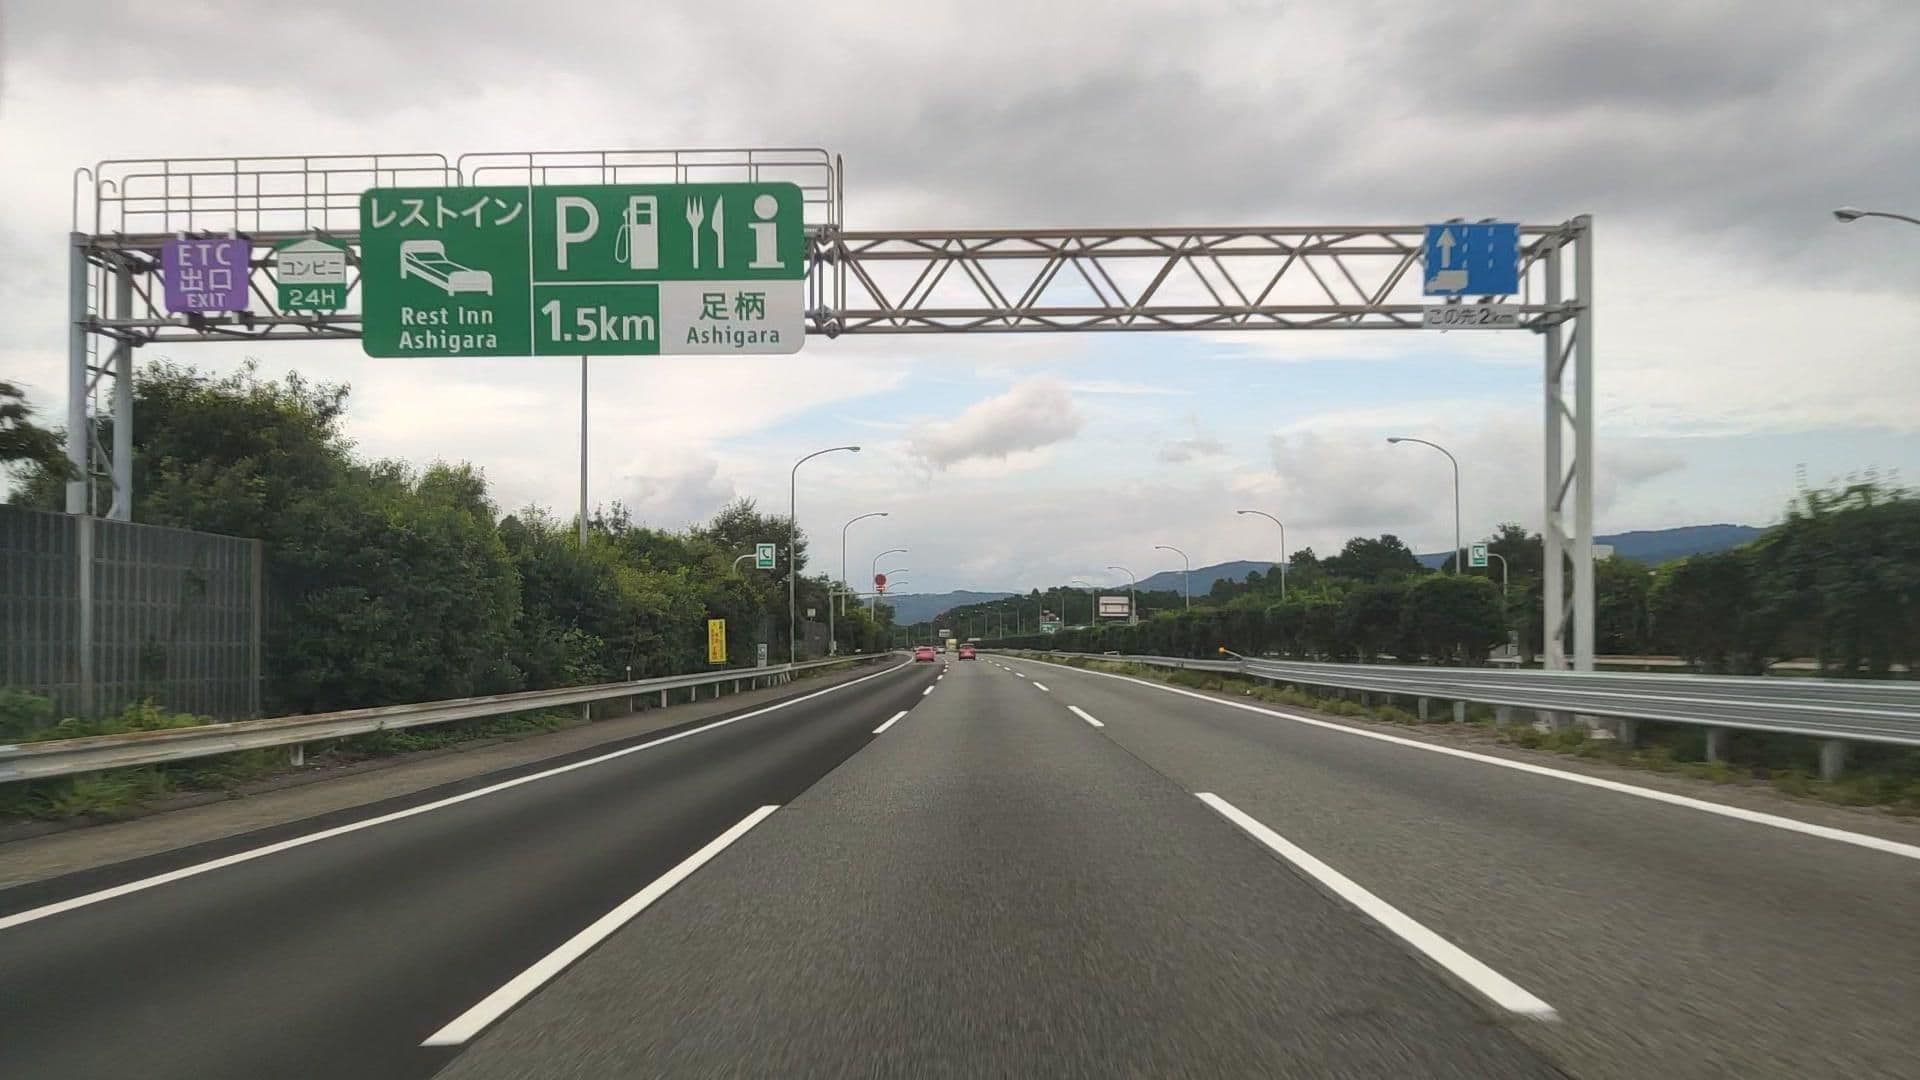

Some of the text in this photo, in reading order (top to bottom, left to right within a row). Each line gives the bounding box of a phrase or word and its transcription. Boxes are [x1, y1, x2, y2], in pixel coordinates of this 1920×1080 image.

[371, 195, 523, 228] レストイン
[178, 244, 231, 266] ETC
[180, 268, 231, 291] 出口
[282, 262, 342, 275] コンビニ
[187, 293, 225, 307] EXIT
[289, 289, 335, 305] 24H
[700, 292, 766, 321] 足柄
[401, 306, 493, 325] Rest Inn
[542, 300, 654, 342] 1.5km
[400, 331, 497, 353] Ashigara
[687, 326, 780, 347] Ashigara
